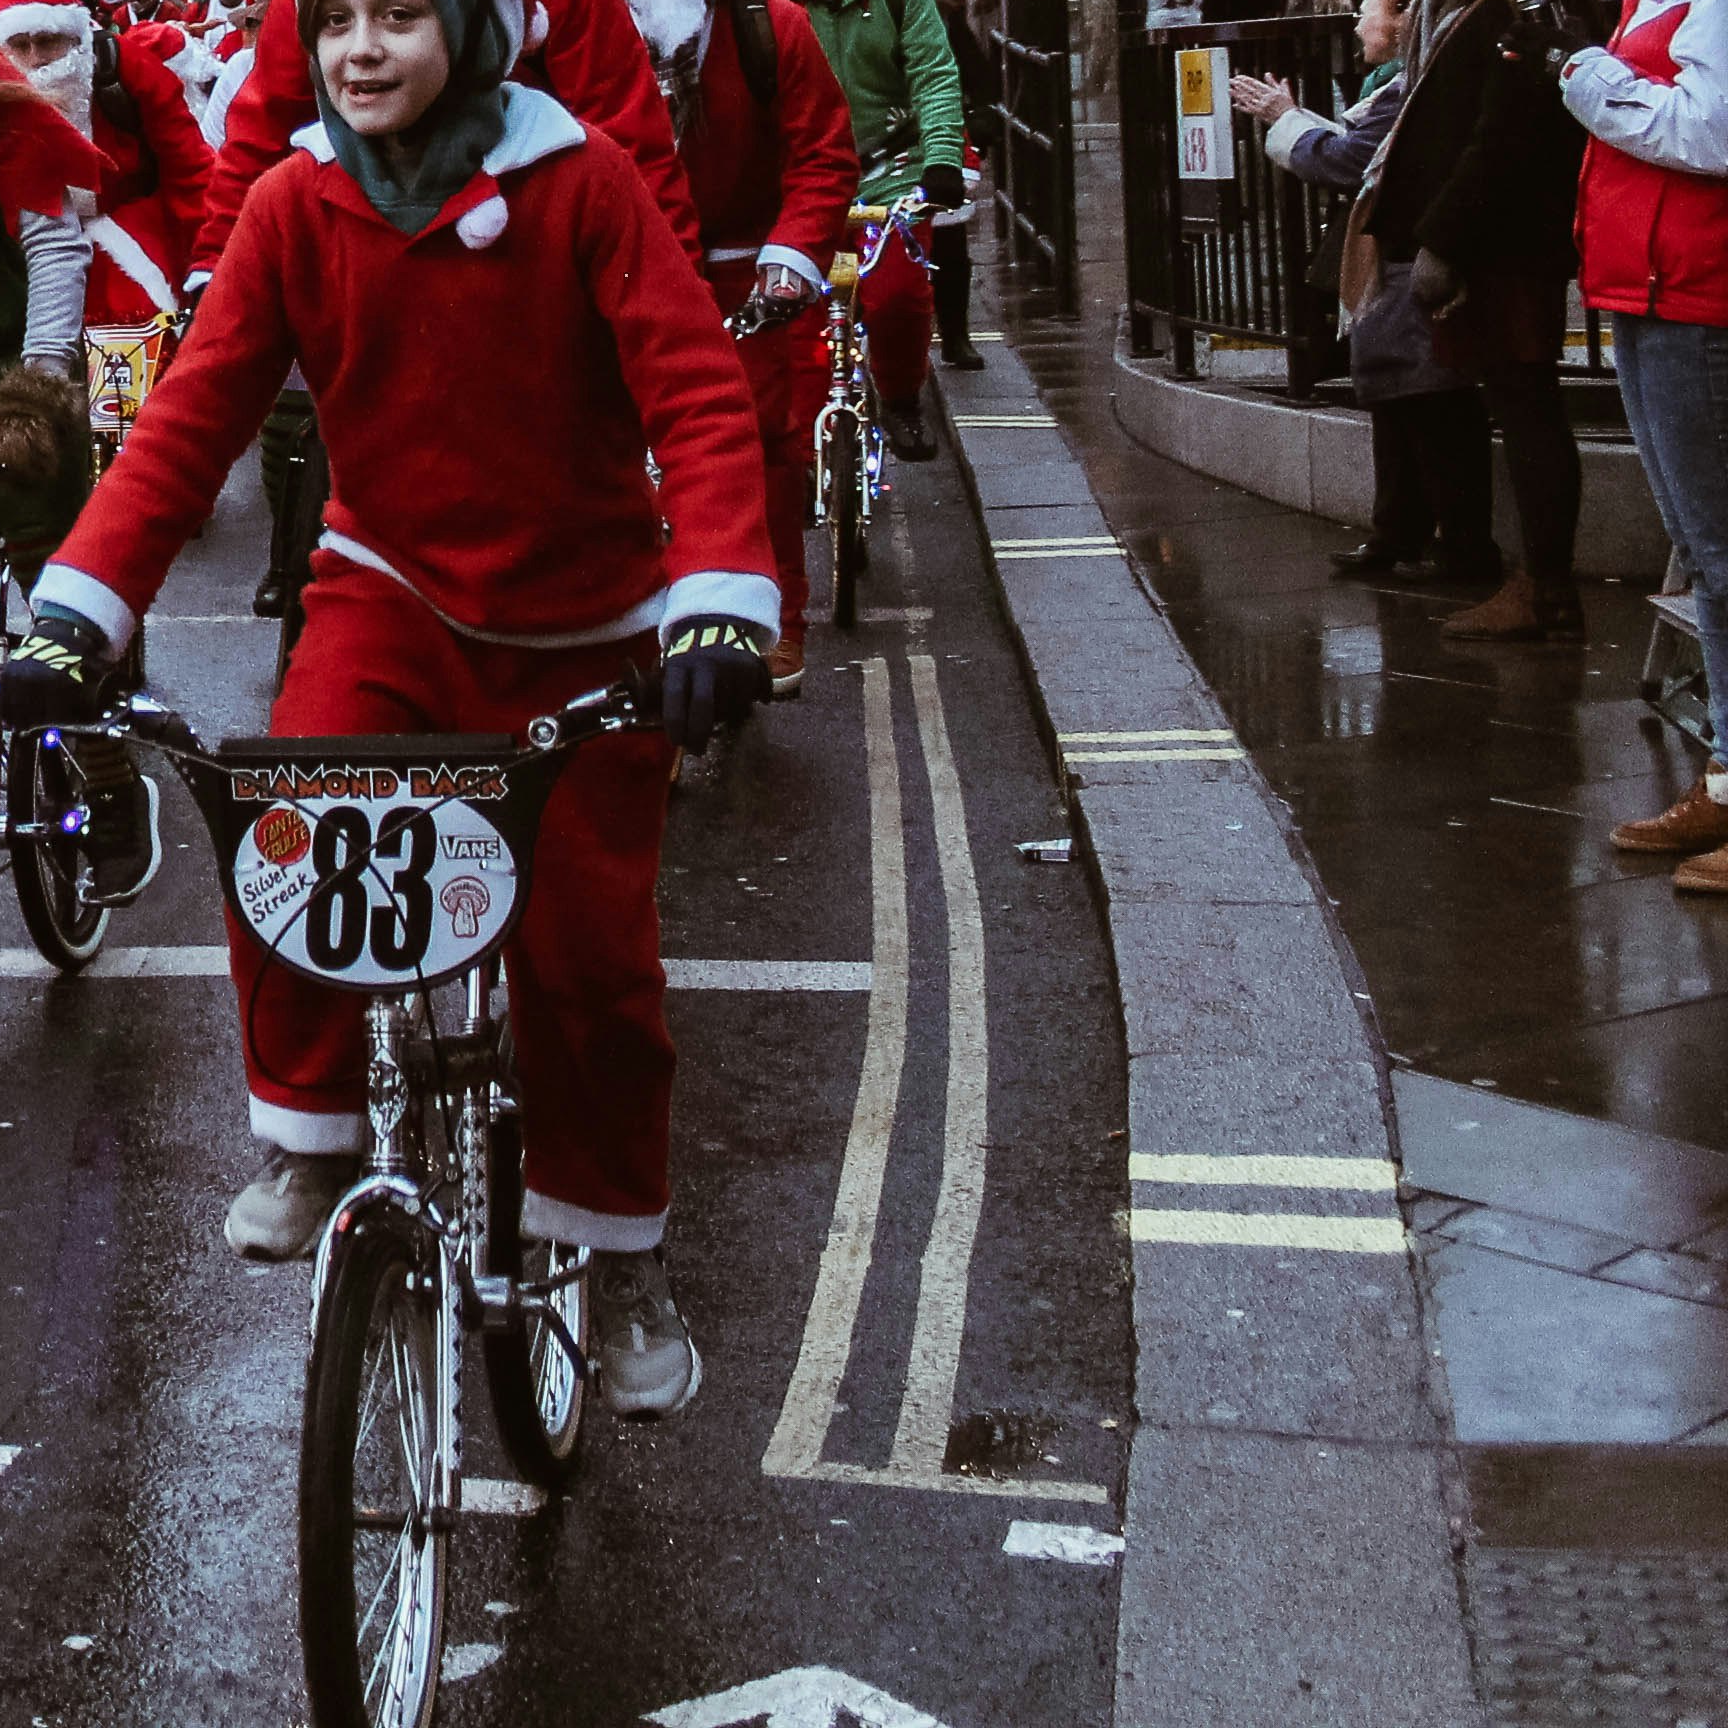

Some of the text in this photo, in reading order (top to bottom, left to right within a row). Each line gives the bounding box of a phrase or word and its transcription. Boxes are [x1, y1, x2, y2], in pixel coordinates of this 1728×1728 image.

[231, 762, 509, 802] DIAMOND BACK
[261, 808, 302, 846] SANTA
[440, 836, 499, 858] VANS
[244, 866, 288, 903] Silver
[252, 873, 315, 924] Streak
[306, 806, 438, 971] 83
